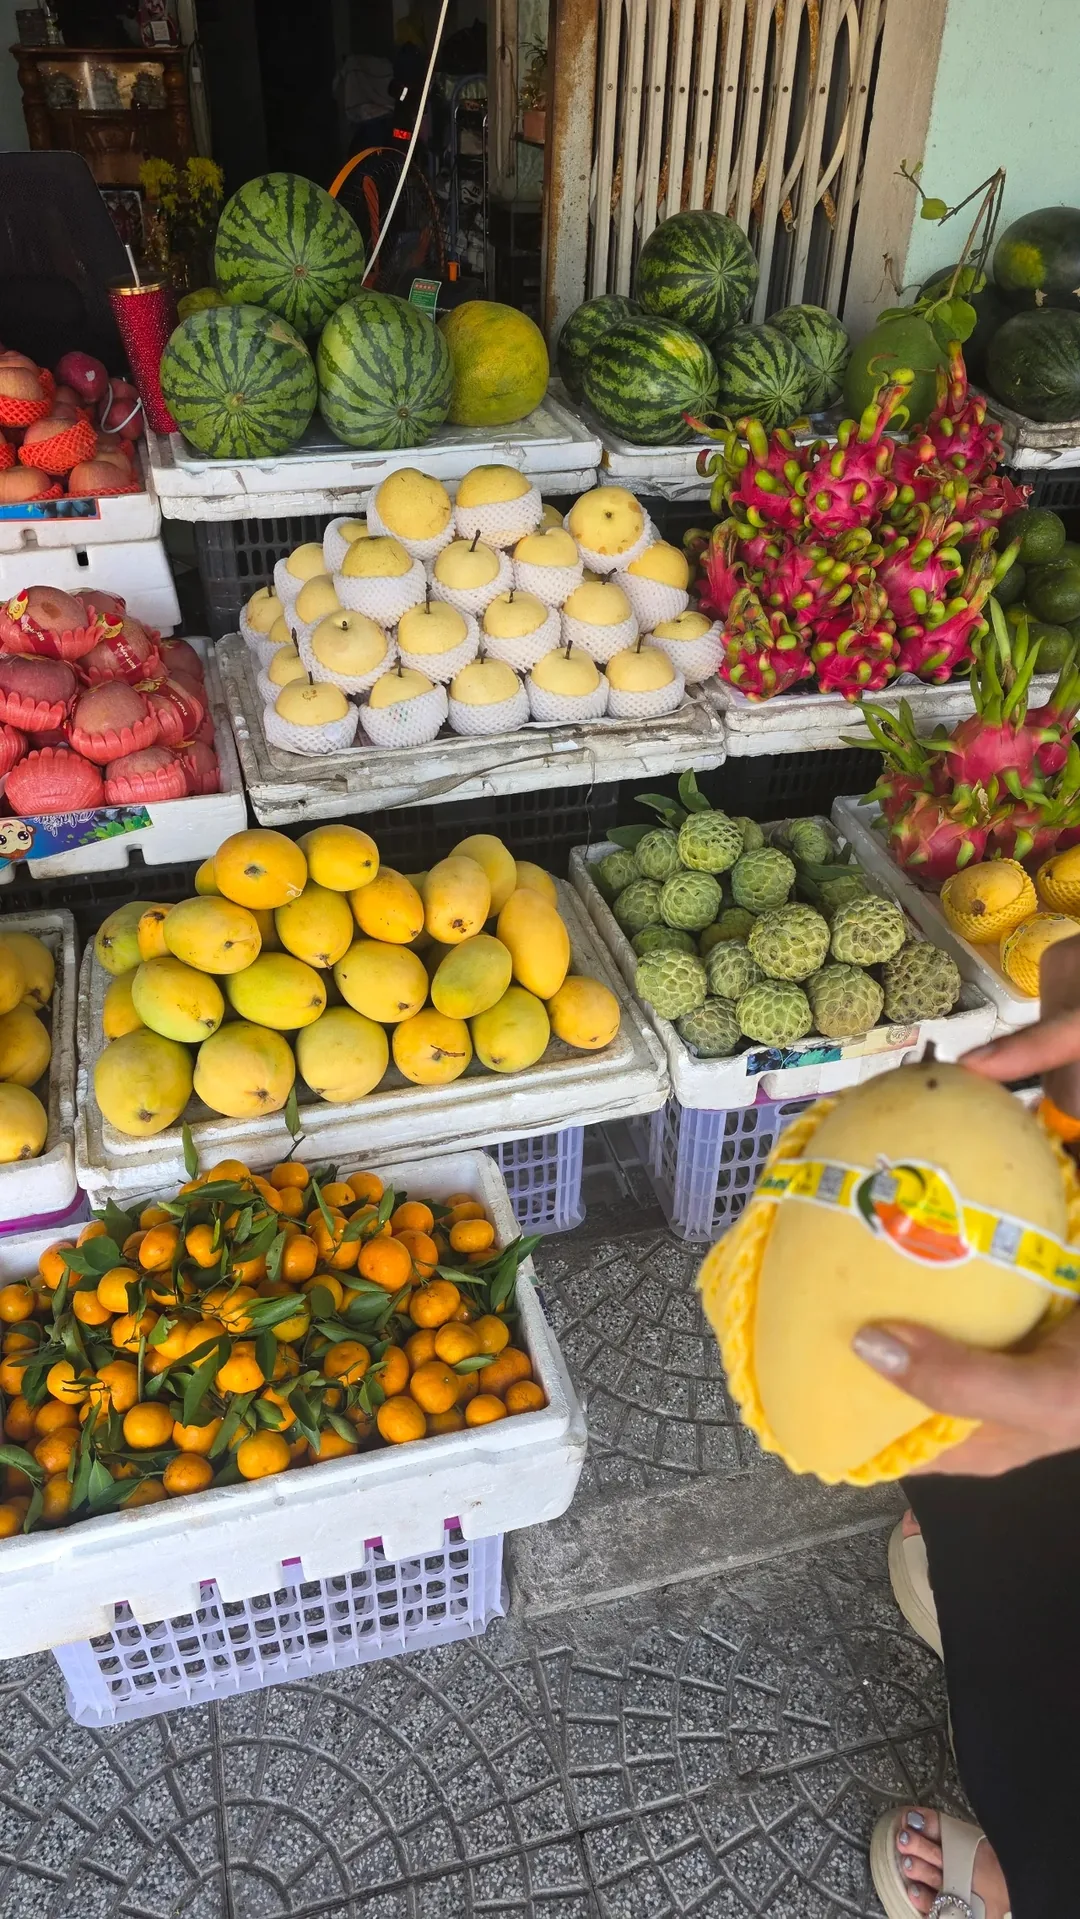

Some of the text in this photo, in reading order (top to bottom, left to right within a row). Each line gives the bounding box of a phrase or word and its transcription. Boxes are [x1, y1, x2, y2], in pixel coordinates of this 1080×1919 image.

[116, 641, 137, 670] BEST APPLE
[176, 701, 188, 717] APPLE
